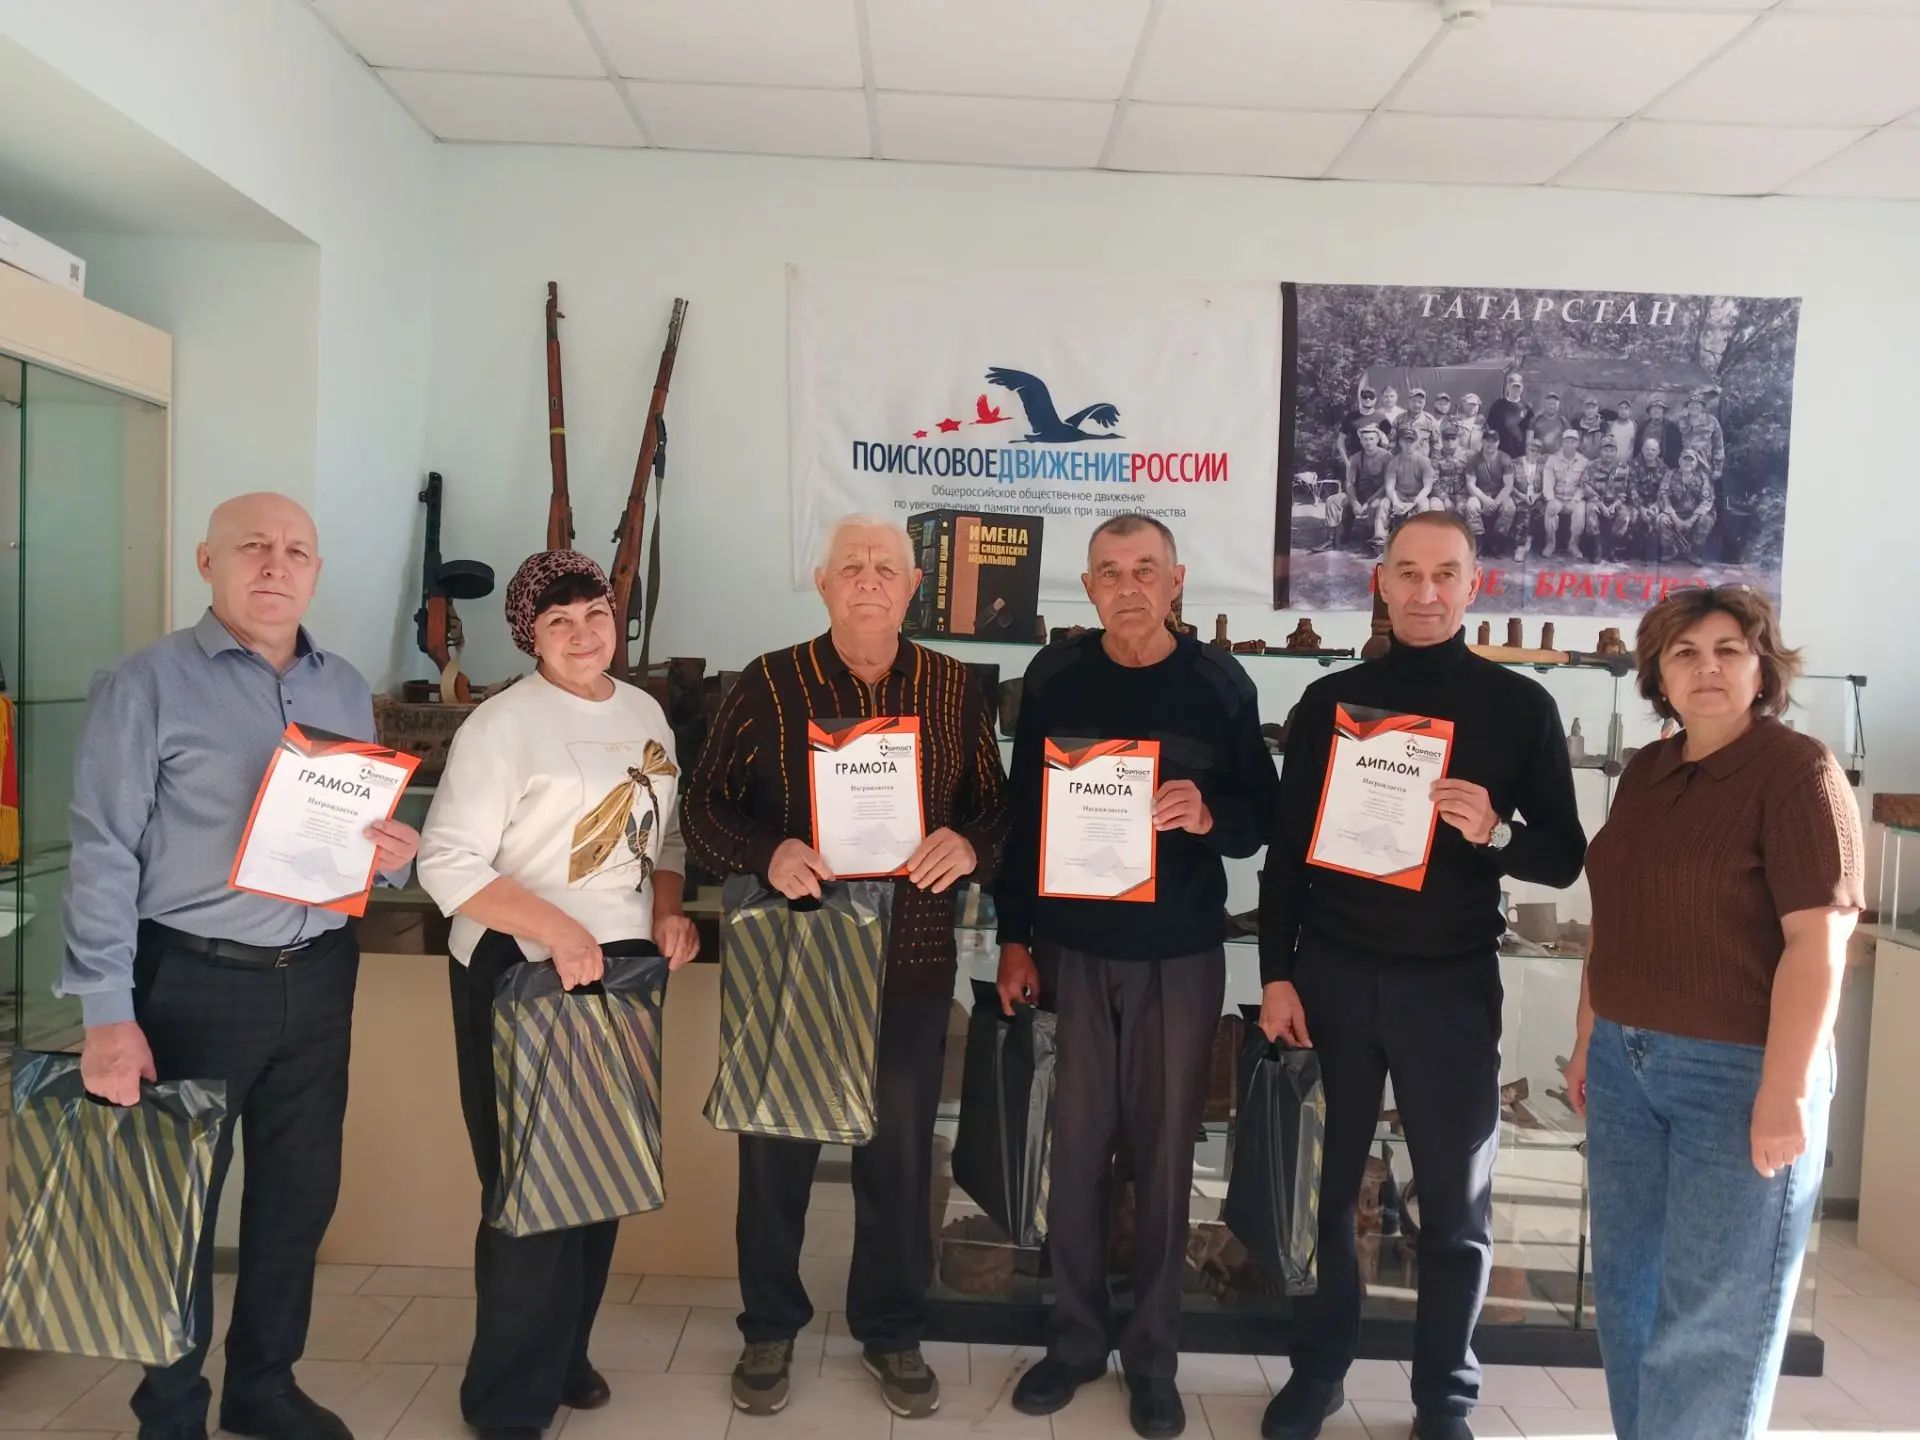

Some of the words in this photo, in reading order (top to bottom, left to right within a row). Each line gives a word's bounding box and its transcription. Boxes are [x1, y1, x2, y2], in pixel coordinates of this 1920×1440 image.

[1418, 293, 1678, 327] ТАТАРСТАН
[932, 484, 1016, 499] Общероссийское
[1019, 487, 1092, 501] общественное
[1094, 492, 1145, 503] движение
[894, 499, 906, 510] по
[984, 504, 1020, 514] памяти
[1022, 503, 1071, 515] погибших
[1074, 507, 1093, 517] при
[969, 525, 1029, 545] ИМЕНА
[836, 761, 897, 774] ГРАМОТА
[1356, 756, 1420, 776] ДИПЛОМ
[298, 769, 371, 799] ГРАМОТА
[1069, 782, 1132, 796] ГРАМОТА
